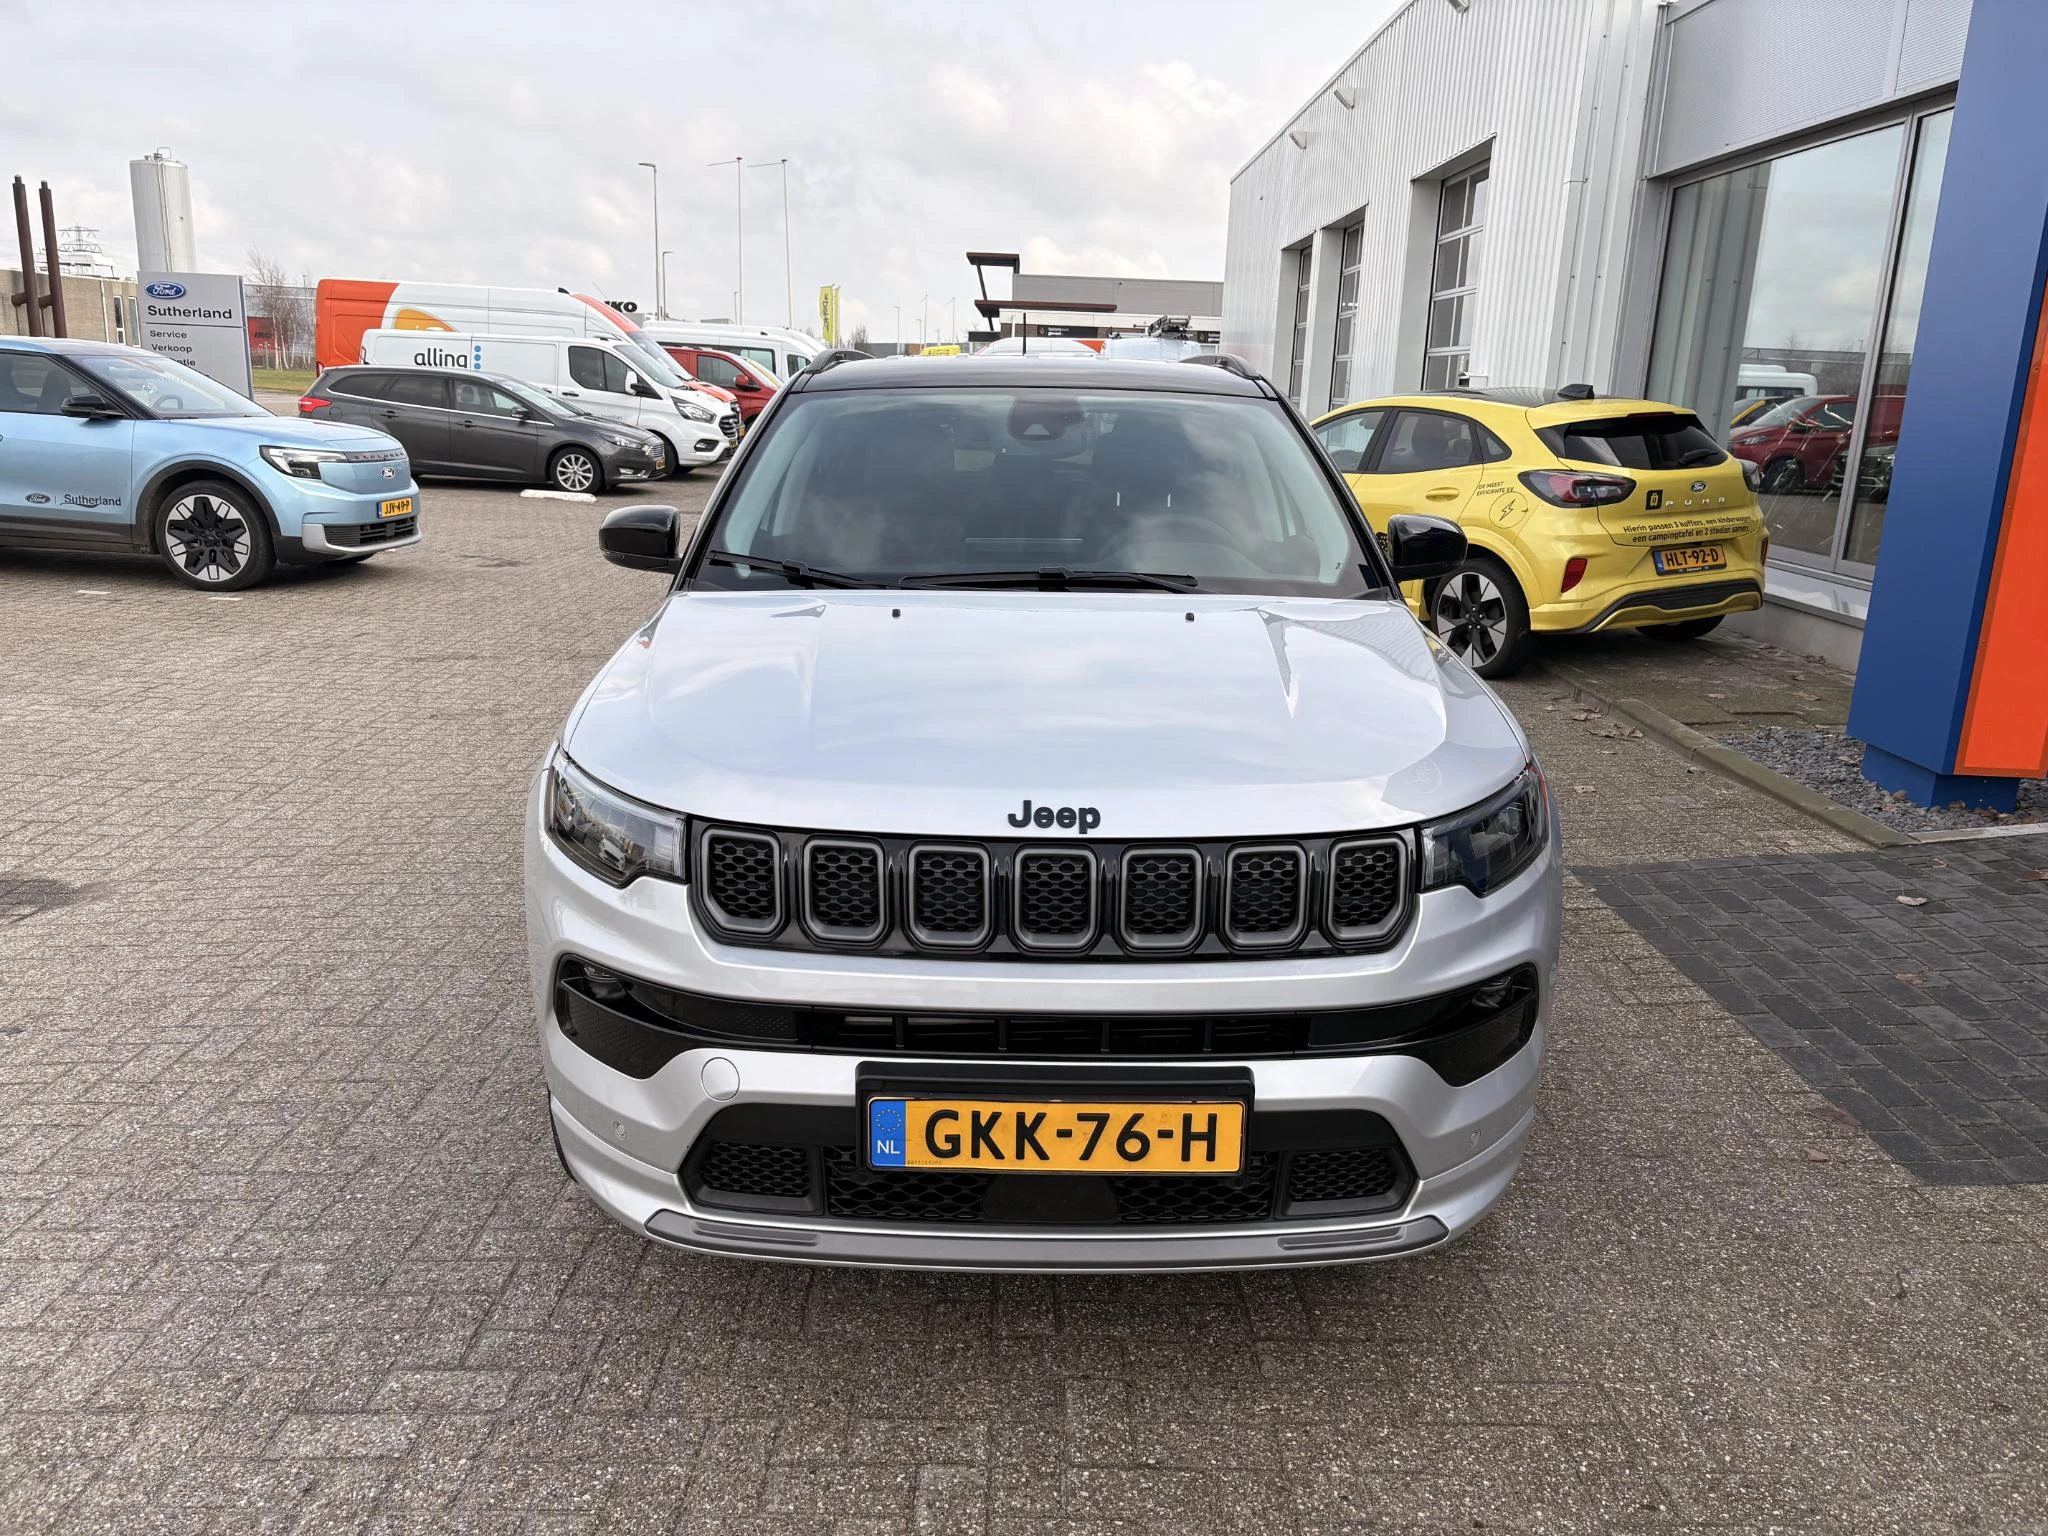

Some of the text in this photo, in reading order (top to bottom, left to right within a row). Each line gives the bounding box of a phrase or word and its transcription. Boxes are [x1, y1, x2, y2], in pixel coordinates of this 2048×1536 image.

[147, 305, 232, 319] Sutherland
[149, 330, 187, 338] Service
[151, 343, 193, 353] Verkoop
[413, 347, 468, 369] allina
[64, 494, 121, 506] Sutherland
[1665, 497, 1725, 506] PUMA
[1623, 525, 1647, 533] Hierin
[1648, 523, 1674, 531] passen
[1648, 529, 1694, 542] campingtafel
[1665, 549, 1719, 567] HLT-92-D
[1007, 799, 1101, 834] Jeep
[876, 1109, 1218, 1163] NL GKK-76-H
